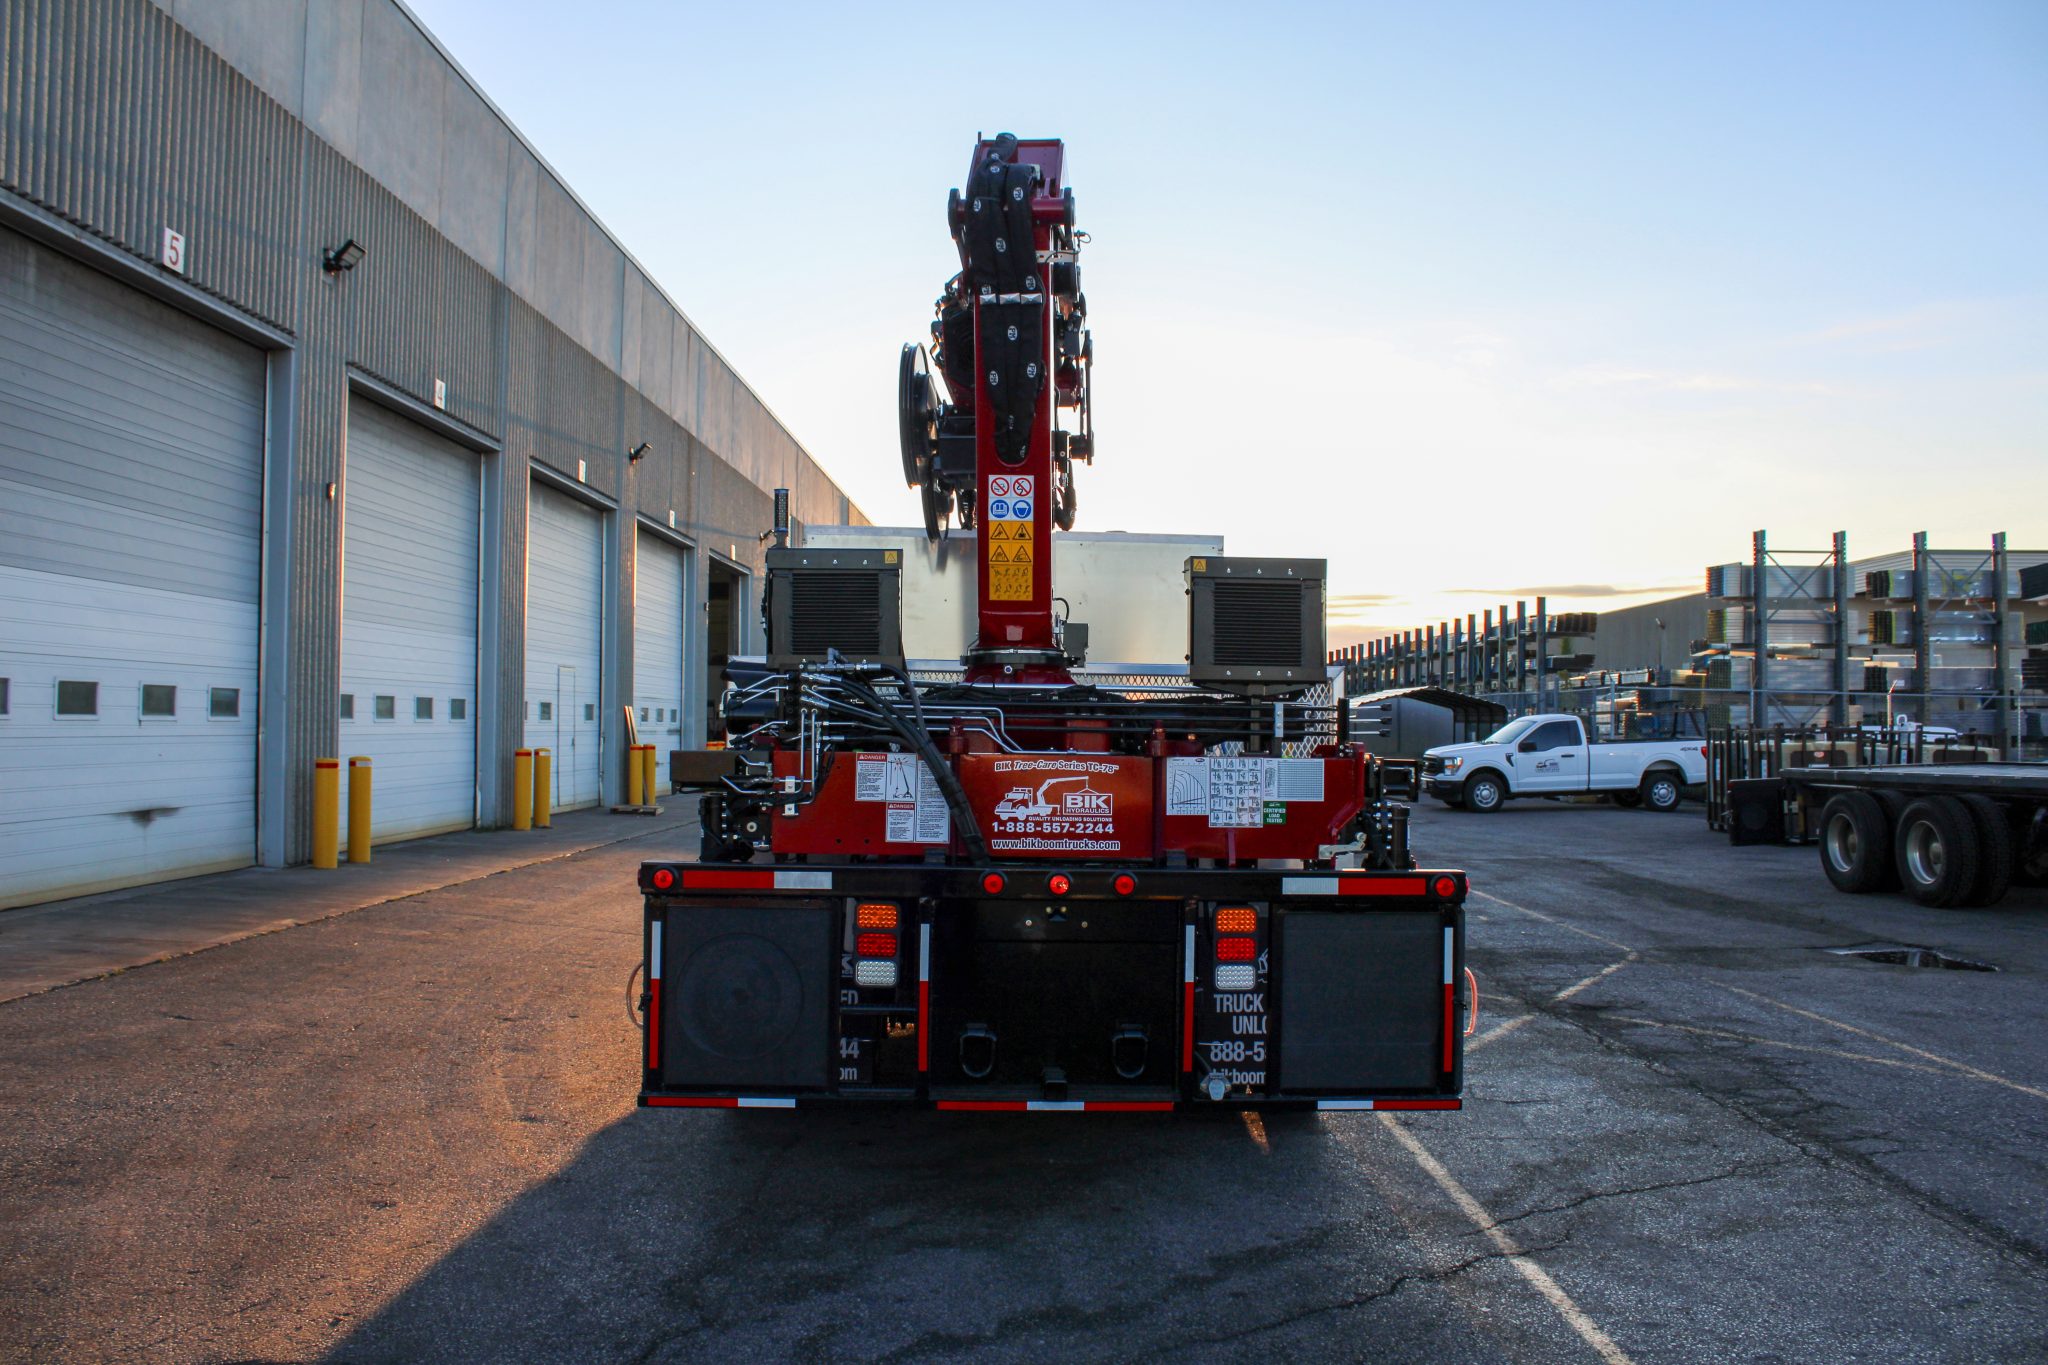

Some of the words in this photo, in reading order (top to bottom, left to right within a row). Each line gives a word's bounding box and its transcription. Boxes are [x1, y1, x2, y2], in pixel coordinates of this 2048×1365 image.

[169, 235, 180, 266] 5
[995, 761, 1011, 772] BIK
[1014, 760, 1059, 770] Tree-Care
[1058, 760, 1086, 770] Series
[1066, 795, 1110, 808] BIK
[992, 821, 1114, 834] 1-888-557-2244
[992, 838, 1120, 850] www.bikboomtrucks.com
[1213, 993, 1265, 1013] TRUCK
[1210, 1040, 1266, 1062] 888-5
